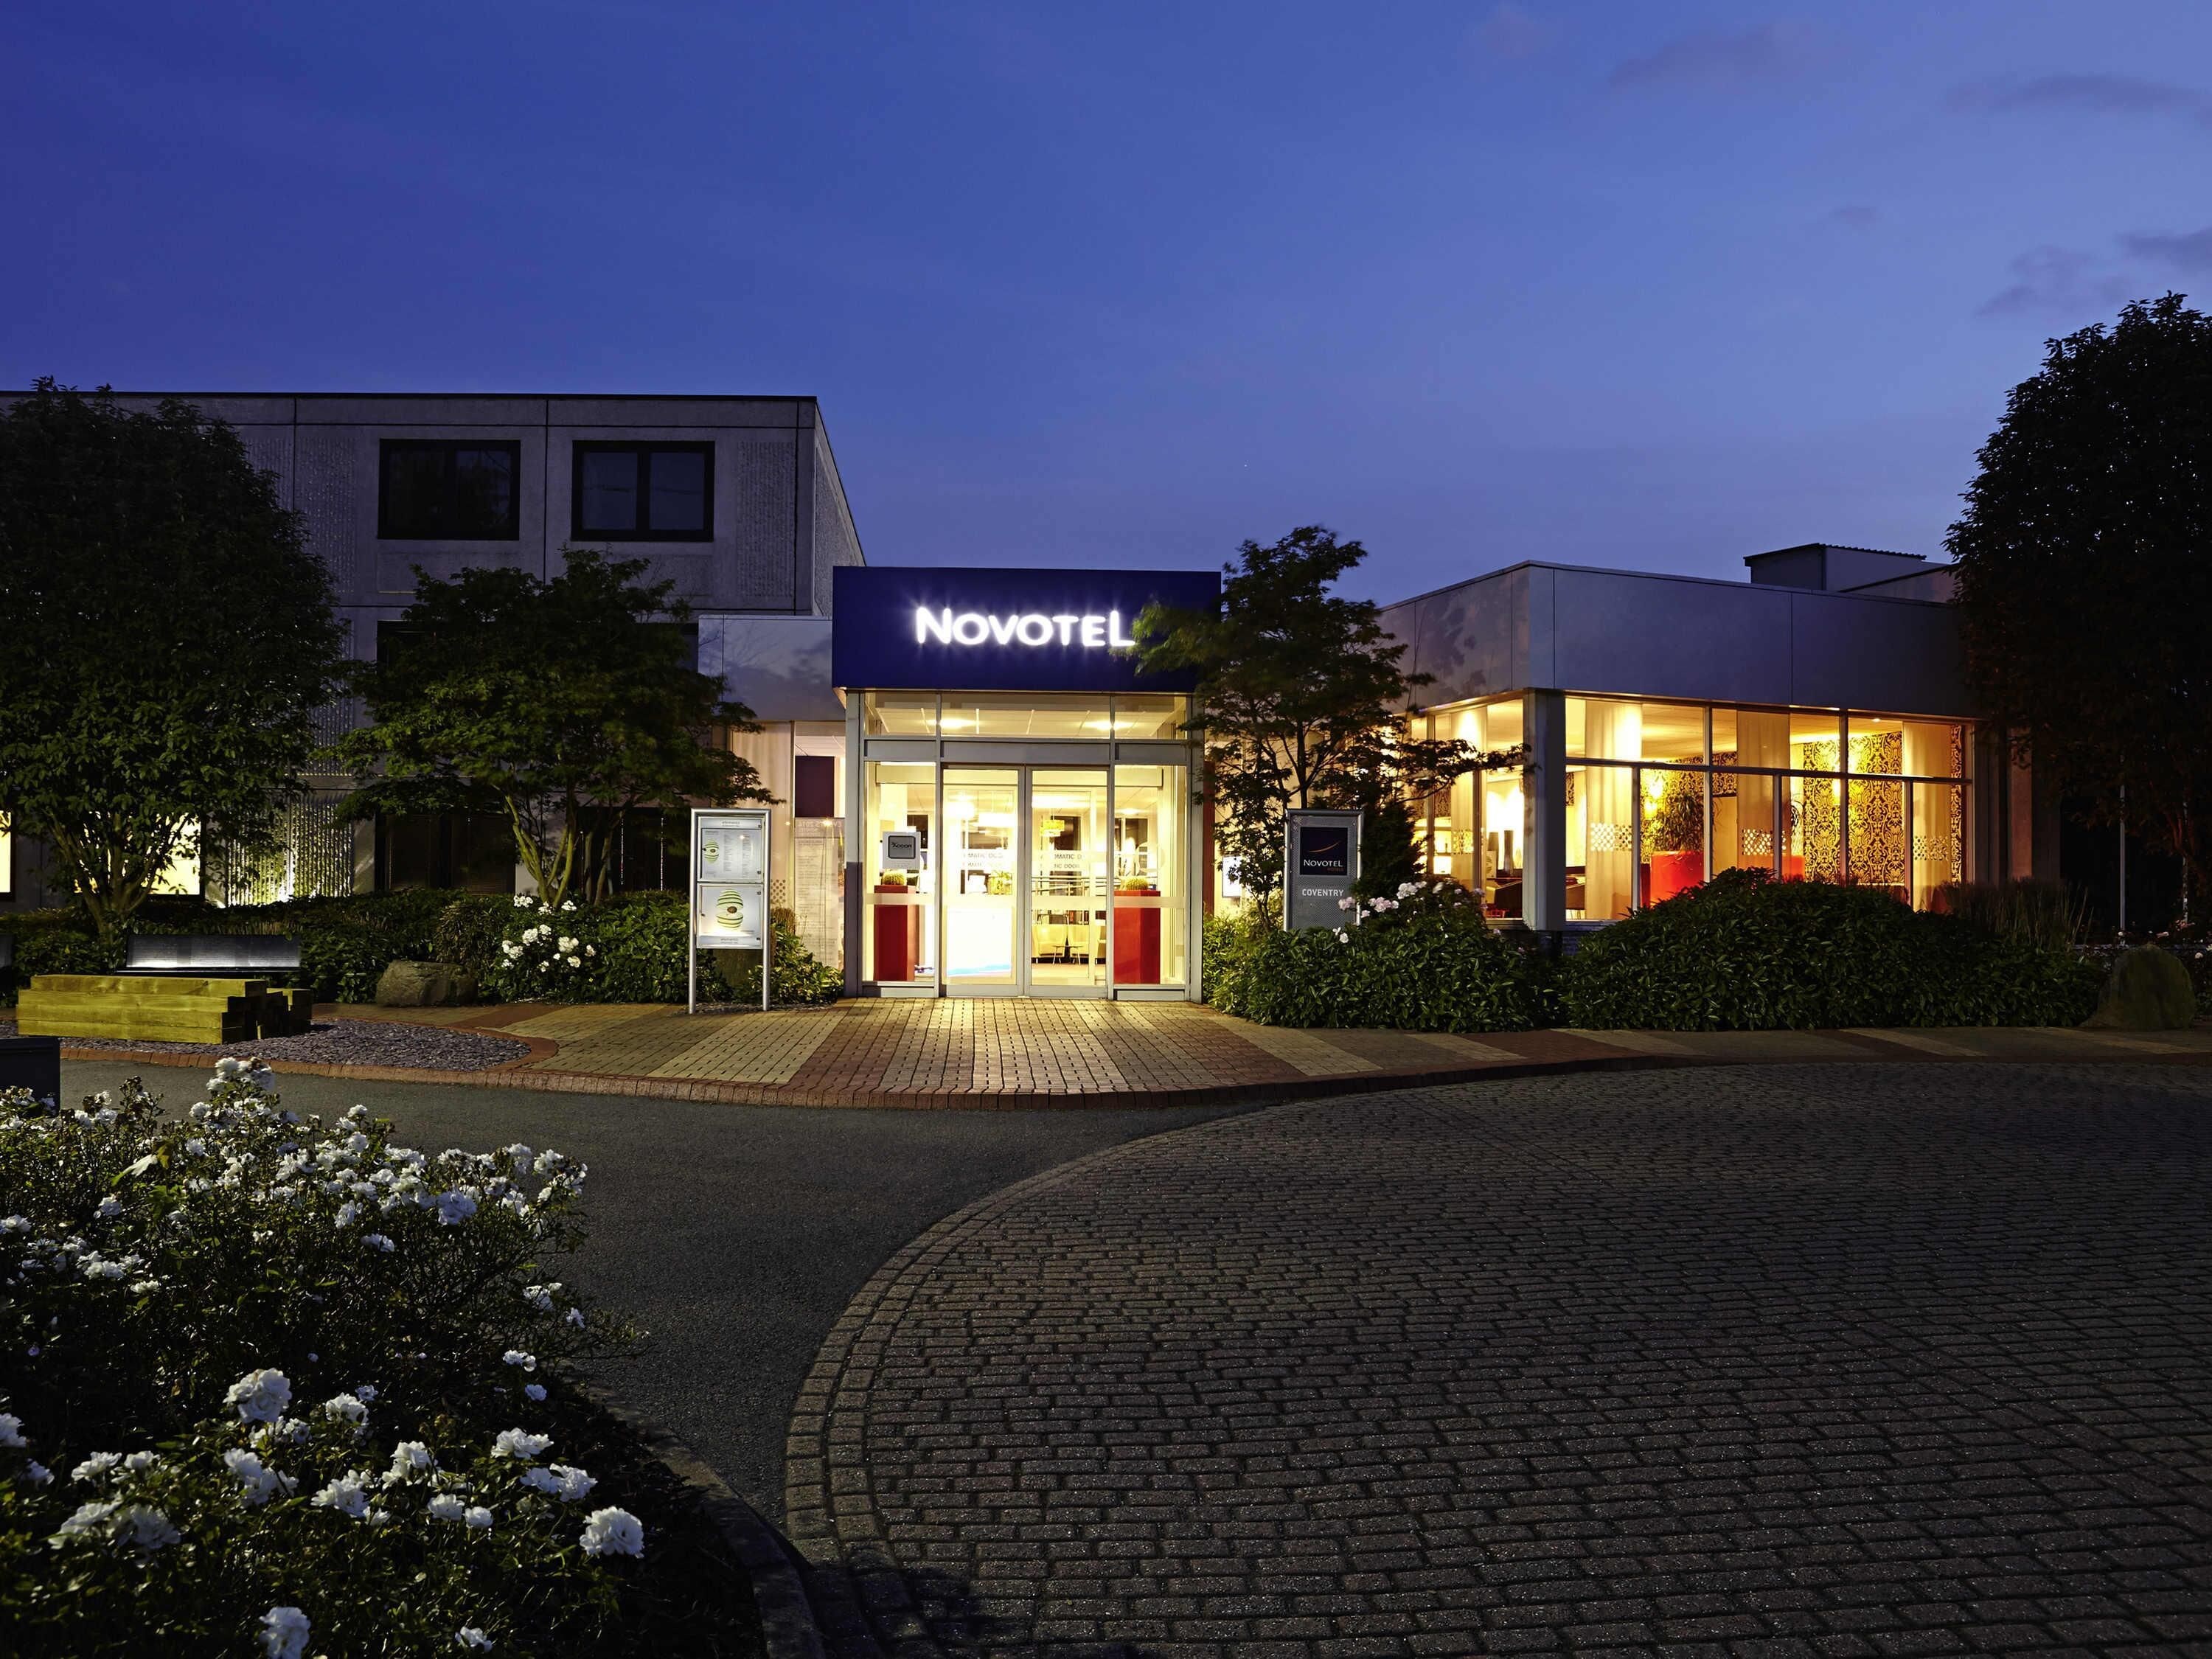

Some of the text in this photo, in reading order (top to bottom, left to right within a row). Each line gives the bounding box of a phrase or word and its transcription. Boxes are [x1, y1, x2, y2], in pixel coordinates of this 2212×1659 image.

[916, 607, 1135, 647] NOVOTEL
[1304, 859, 1343, 867] NOVOTEL
[1302, 888, 1343, 897] COVENTRY
